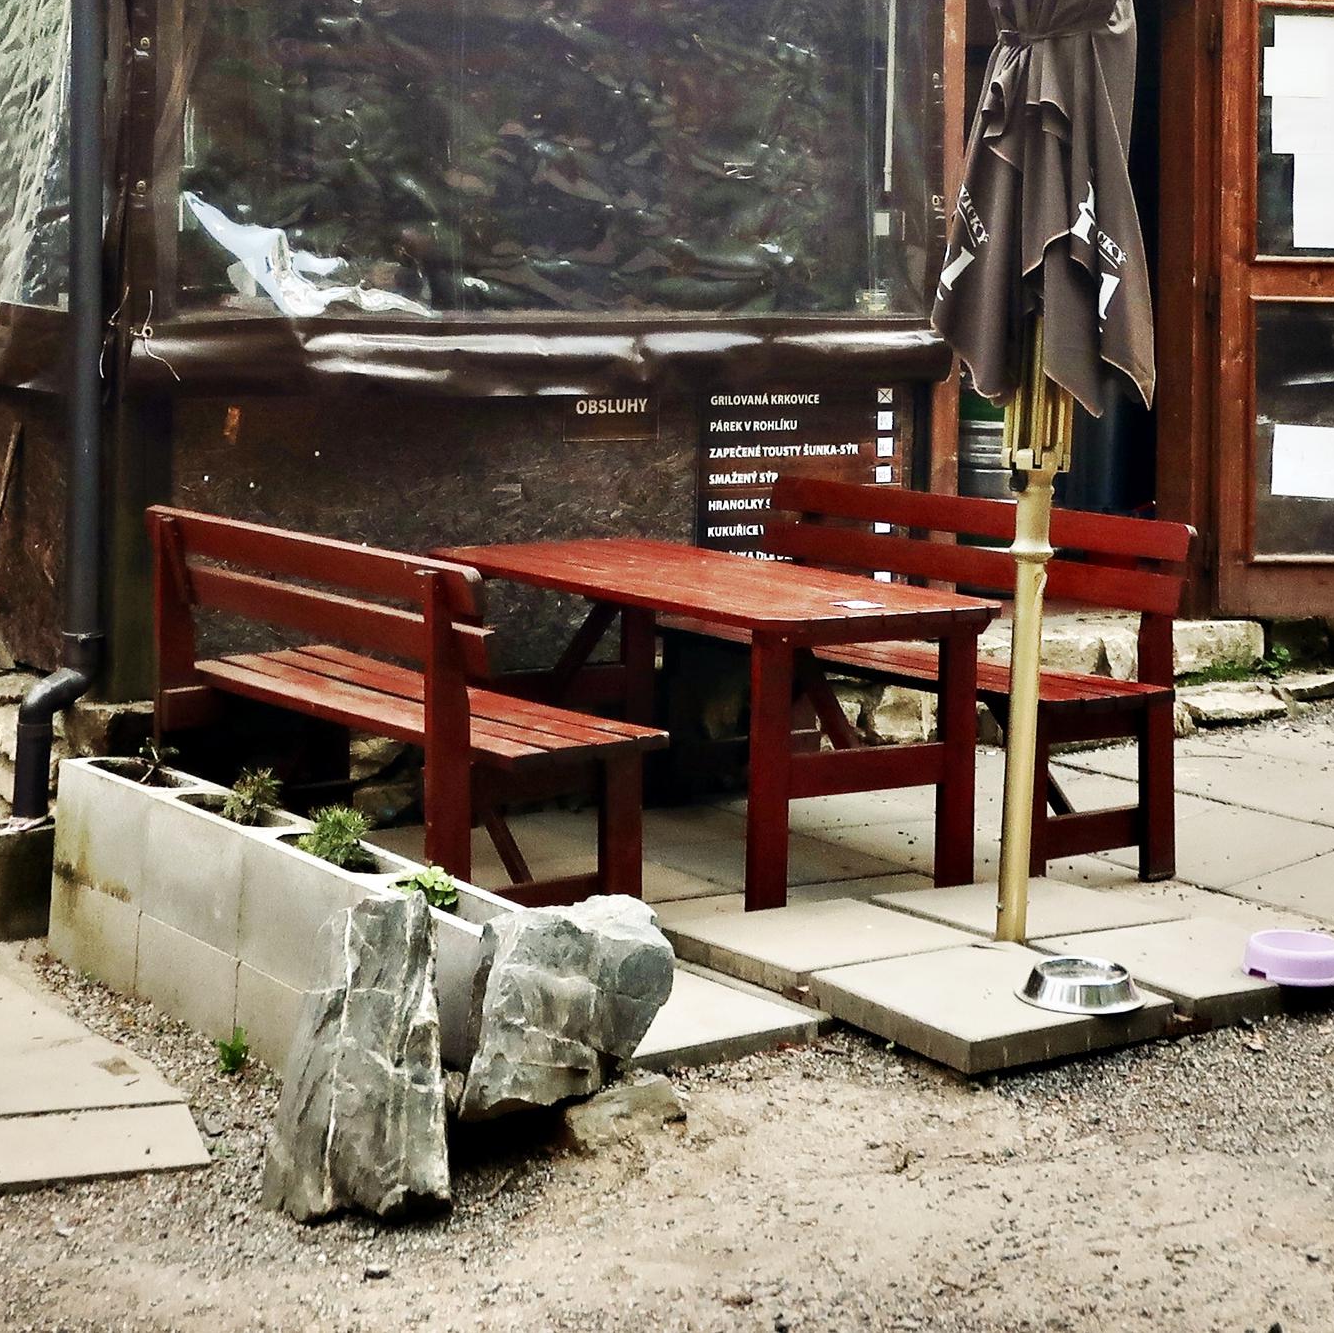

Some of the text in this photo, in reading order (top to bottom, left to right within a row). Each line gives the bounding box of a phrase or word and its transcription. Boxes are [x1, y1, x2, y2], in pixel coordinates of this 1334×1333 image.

[710, 392, 820, 406] GRILOVANÁ KRKOVICE
[575, 398, 648, 415] OBSLUHY
[709, 418, 798, 432] PÁREK V ROHLÍKU
[709, 443, 859, 458] ZAPEČENÉ TOUSTY ŠUNKA-SÝR
[709, 471, 757, 484] SMAŽENÝ
[708, 499, 764, 511] HRANOLKY
[707, 524, 759, 537] KUKUŘICE
